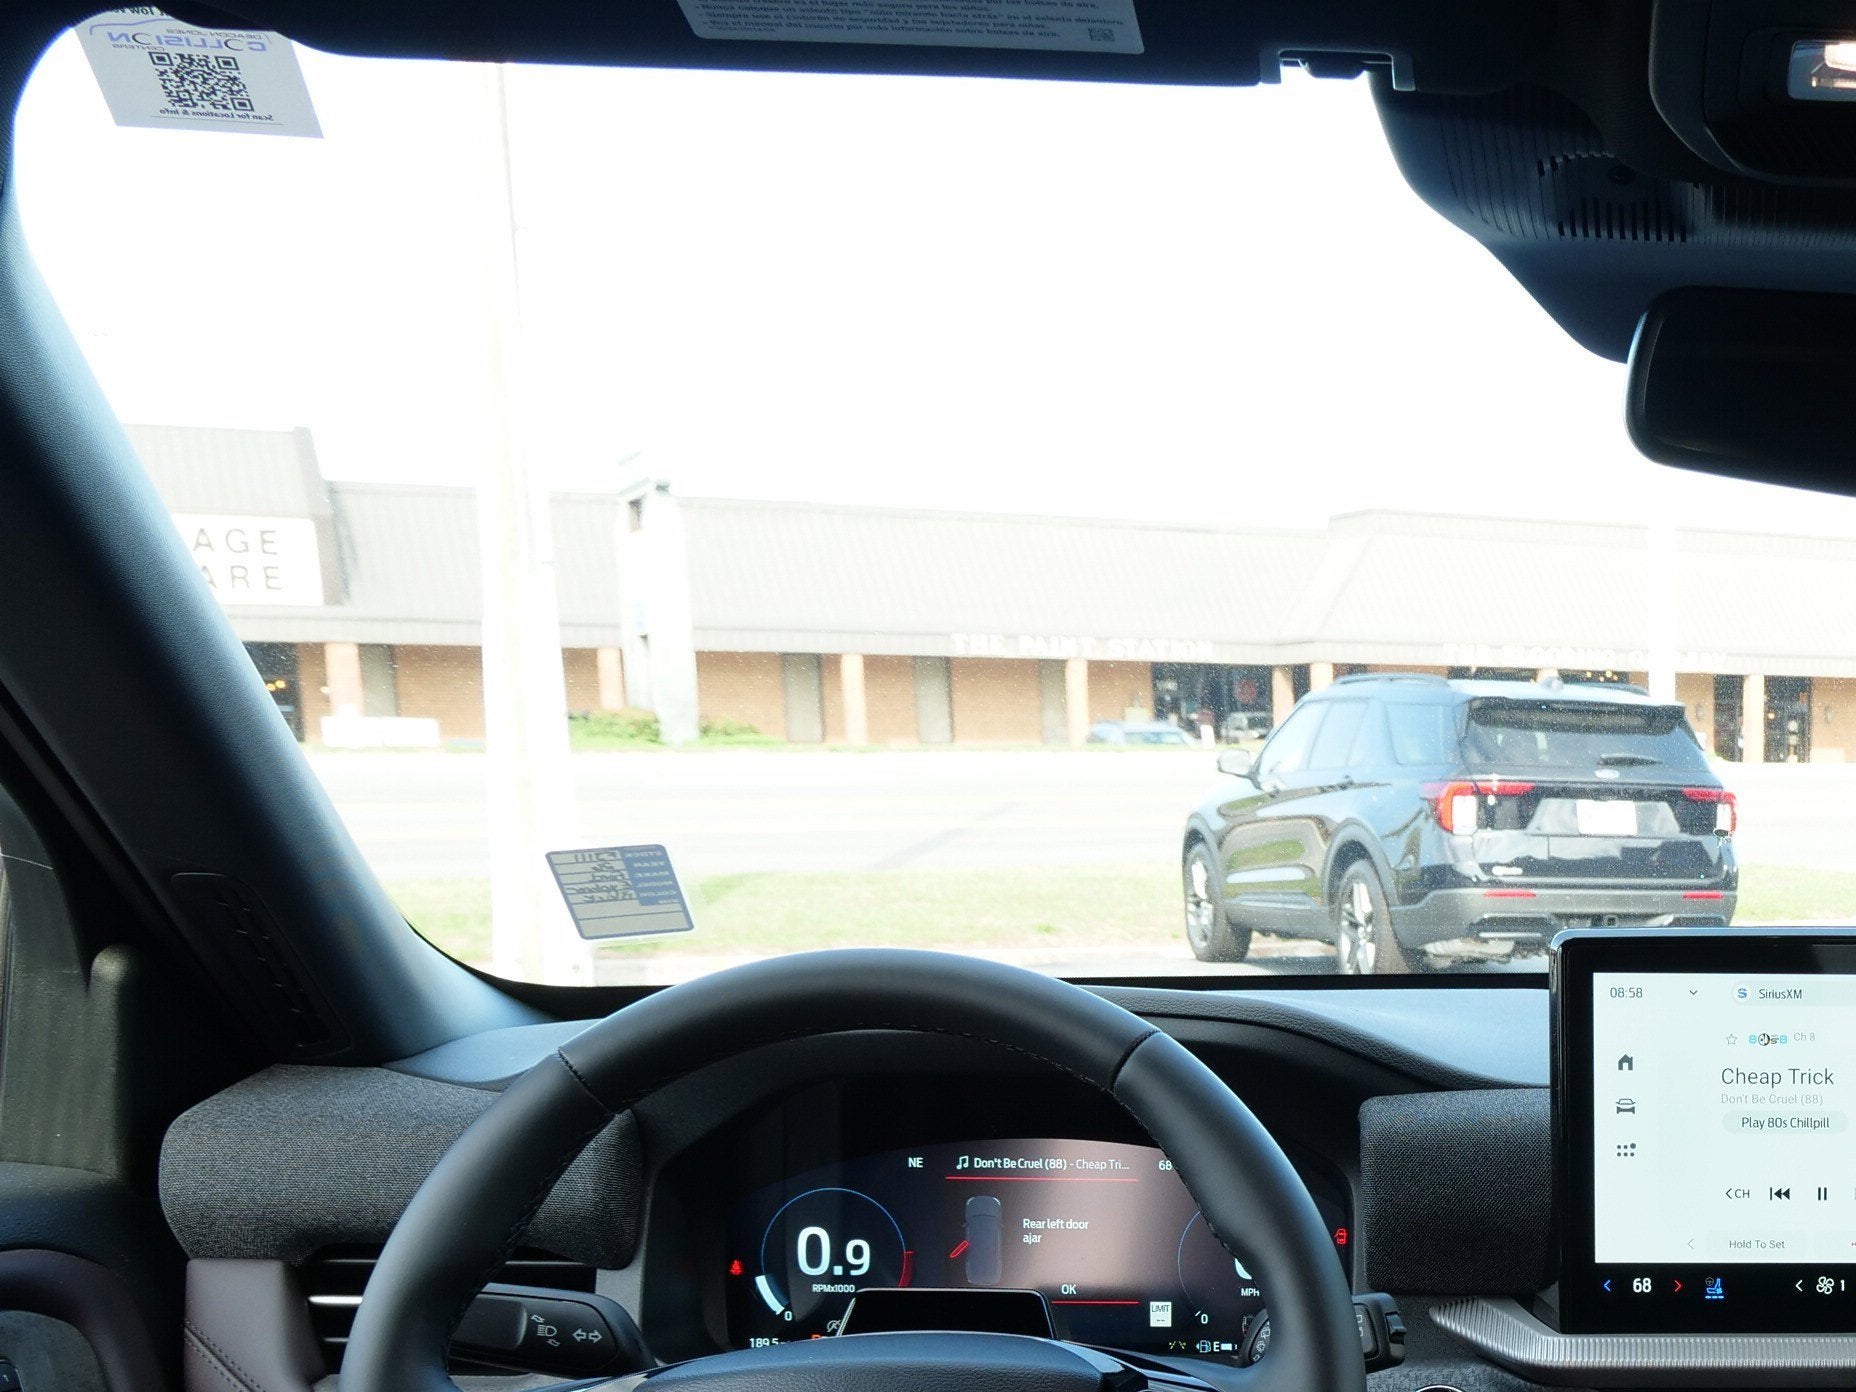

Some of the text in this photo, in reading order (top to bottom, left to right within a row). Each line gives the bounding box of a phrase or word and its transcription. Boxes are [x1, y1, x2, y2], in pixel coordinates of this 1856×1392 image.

[951, 633, 1005, 656] THE
[1609, 987, 1643, 999] 08:58
[1758, 988, 1803, 1000] SiriusXM
[1793, 1032, 1816, 1042] Ch 8
[1721, 1067, 1835, 1089] Cheap Trick
[1720, 1094, 1824, 1106] Don't Be Cruel (88)
[1741, 1117, 1830, 1131] Play 80s Chillpill
[908, 1157, 924, 1169] NE
[973, 1157, 1003, 1169] Don't
[1003, 1158, 1017, 1169] Be
[1017, 1158, 1043, 1169] Cruel
[1044, 1158, 1067, 1171] (88)
[1076, 1158, 1107, 1171] Cheap
[1158, 1160, 1173, 1171] 68
[1734, 1189, 1750, 1199] CH
[1022, 1218, 1090, 1230] Rear left door
[1022, 1232, 1043, 1245] ajar
[1729, 1239, 1786, 1249] Hold To Set
[797, 1226, 871, 1276] 0.9
[812, 1284, 856, 1293] RPMx1000
[1061, 1284, 1077, 1295] OK
[1633, 1278, 1652, 1293] 68
[1839, 1279, 1846, 1291] 1
[1240, 1288, 1260, 1297] MPH
[1151, 1304, 1170, 1313] LIMIT
[784, 1310, 793, 1321] 0
[1200, 1313, 1209, 1325] 0
[1213, 1341, 1220, 1352] E
